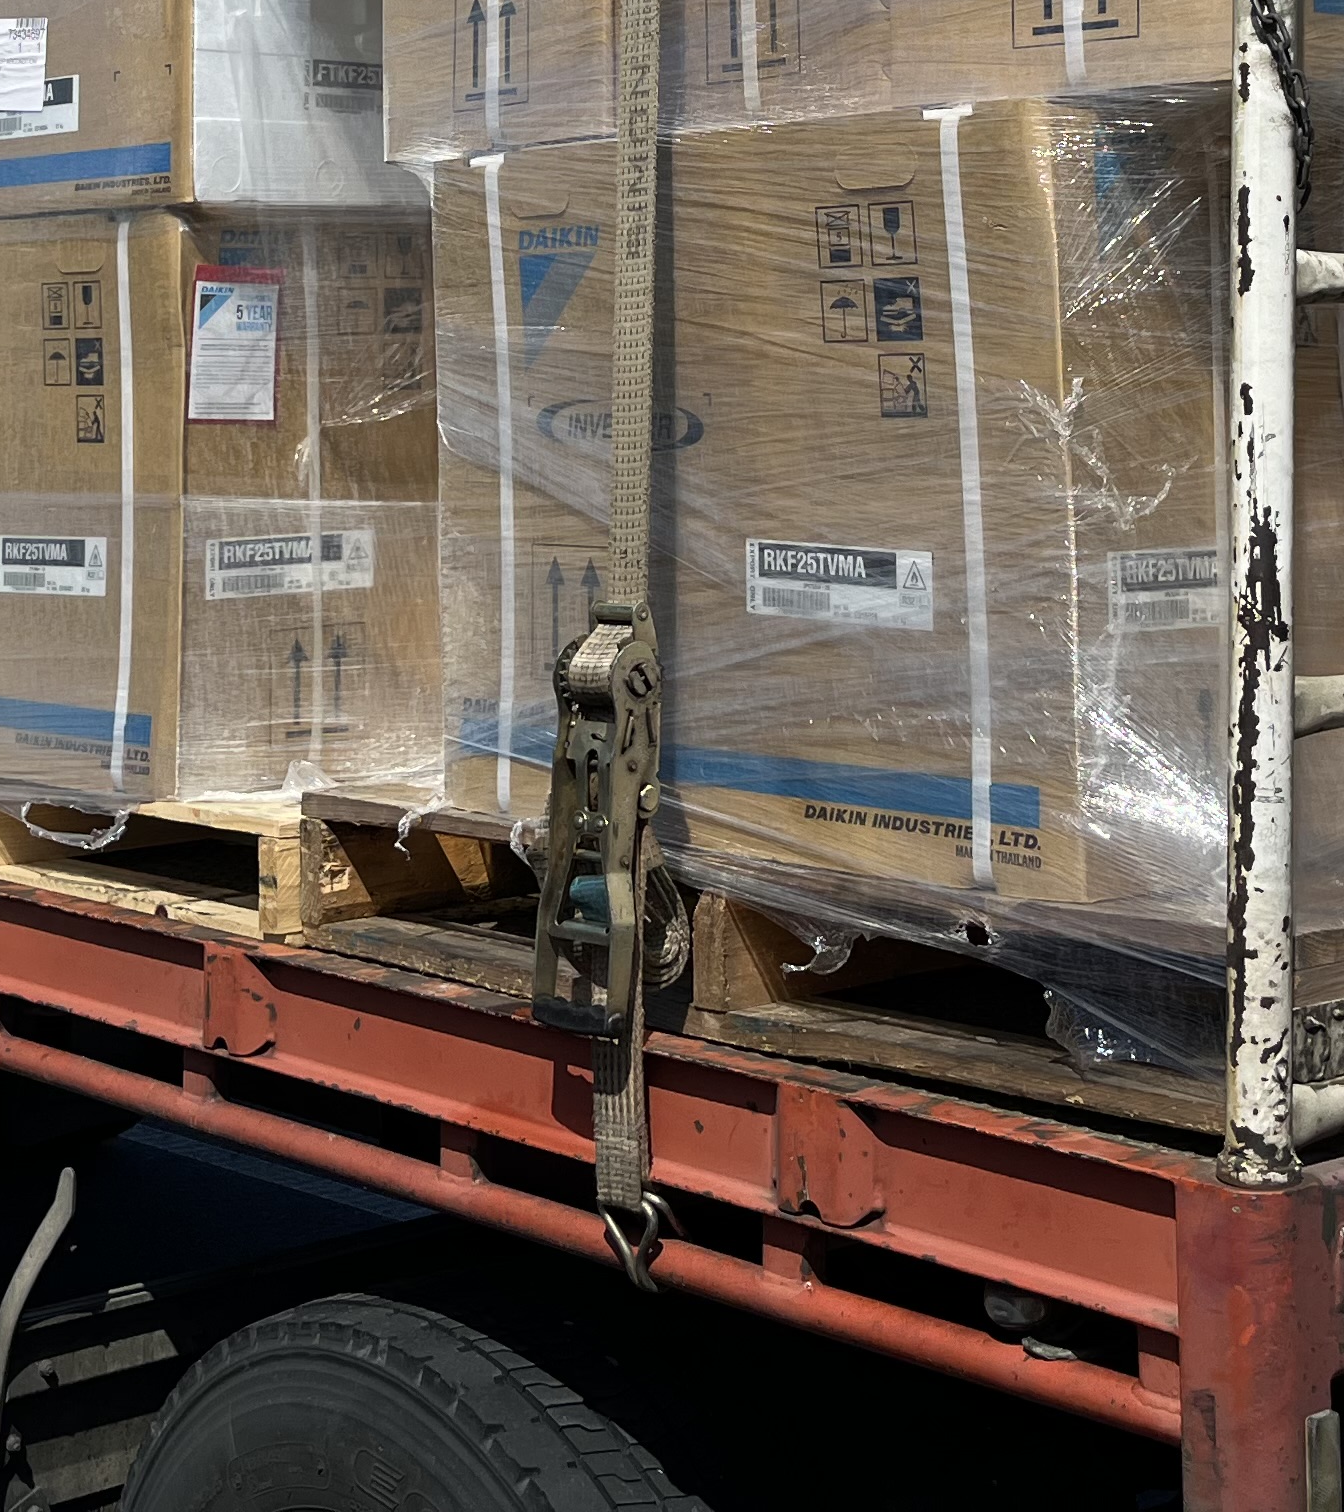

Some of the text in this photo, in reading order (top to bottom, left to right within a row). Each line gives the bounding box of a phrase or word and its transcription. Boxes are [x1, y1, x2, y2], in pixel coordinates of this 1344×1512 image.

[317, 63, 382, 86] FTKF25T
[154, 175, 171, 186] LTD.
[518, 224, 600, 251] DAIKIN
[201, 285, 235, 294] DAIKIN
[236, 304, 273, 322] 5 YEAR
[236, 321, 272, 332] WARRANTY
[5, 542, 68, 561] RKF25TVMA
[763, 548, 866, 579] RKF25TVMA
[15, 732, 151, 763] DAIKIN INDUSTRIE LTD.
[804, 804, 1042, 851] DAIKIN INDUSTRIE, LTD.
[996, 850, 1042, 869] THAILAND
